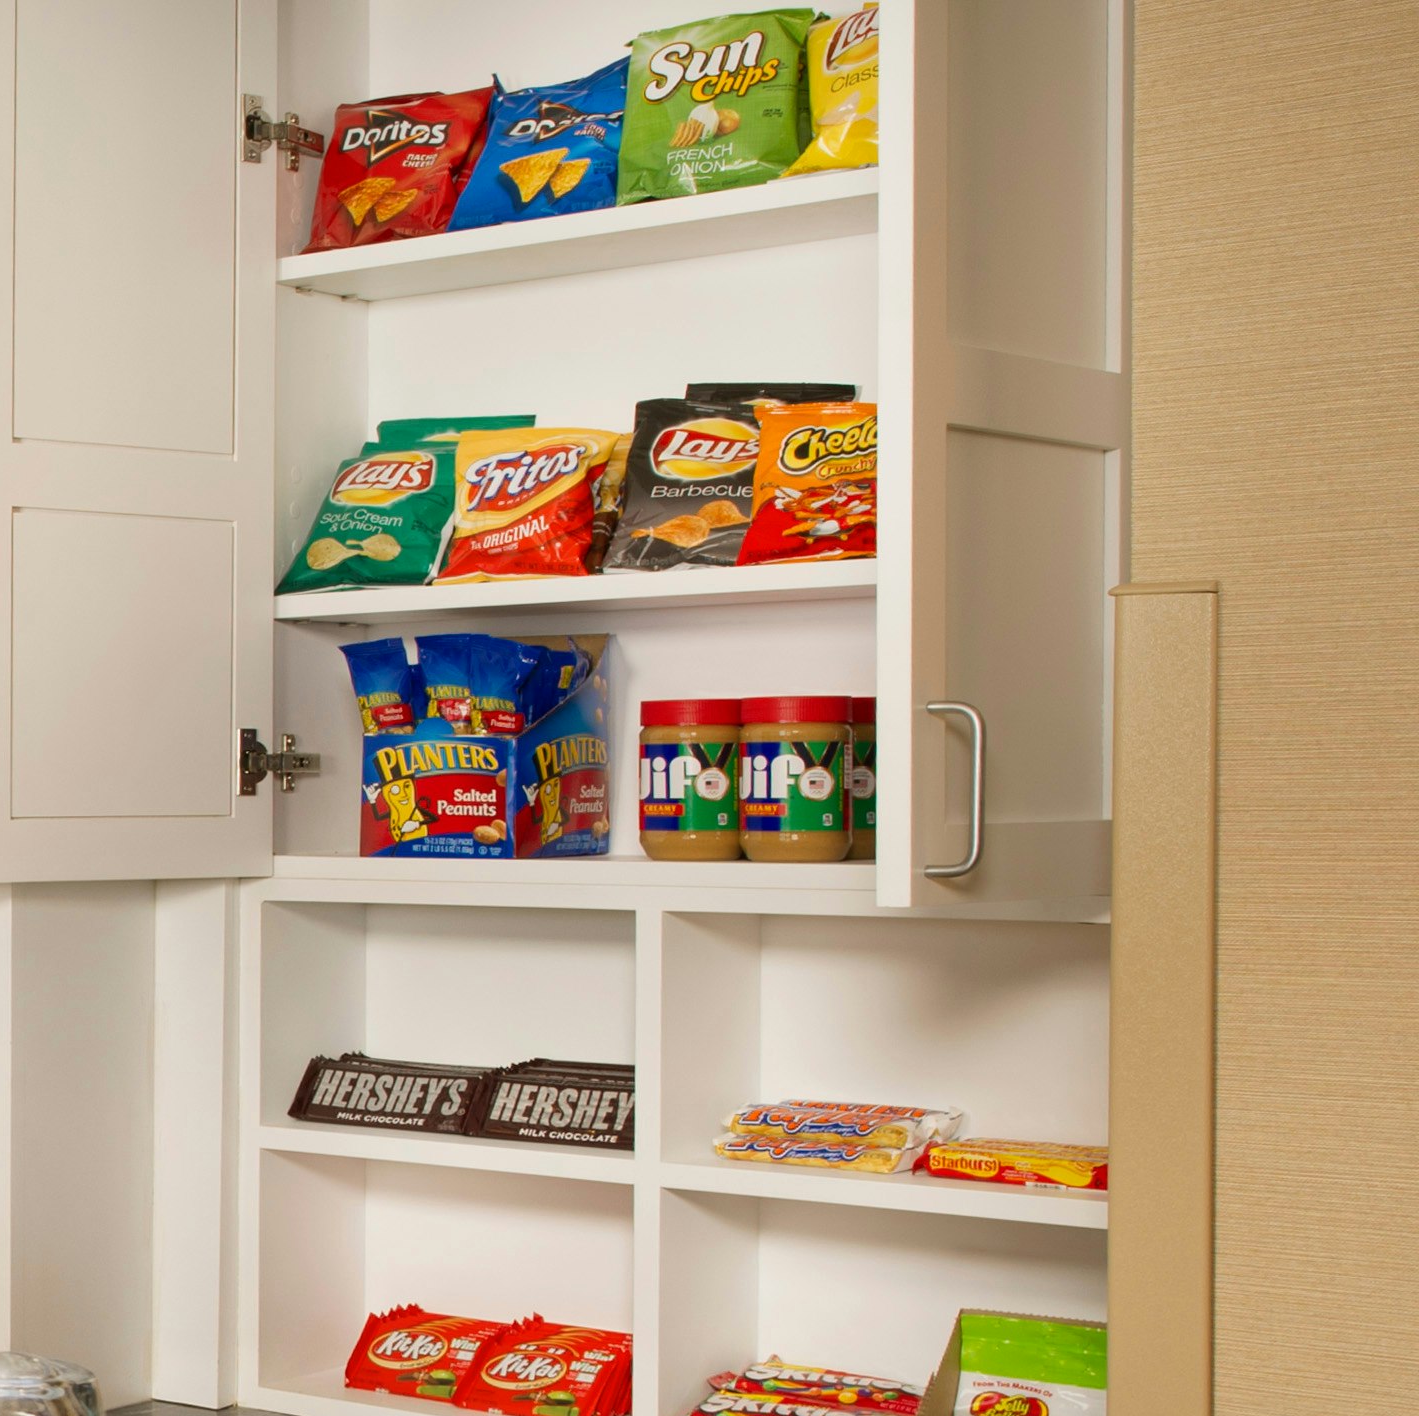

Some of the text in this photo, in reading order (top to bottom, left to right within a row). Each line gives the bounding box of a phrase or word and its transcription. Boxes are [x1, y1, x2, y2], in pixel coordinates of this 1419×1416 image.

[643, 31, 766, 103] Sun
[691, 56, 779, 104] Chips
[830, 63, 880, 92] Class
[342, 118, 448, 155] Doritos
[666, 141, 734, 165] FRENCH
[669, 158, 726, 178] ONION
[335, 456, 433, 491] Lay's
[465, 443, 587, 510] Fritos
[650, 483, 753, 500] Barbecue
[320, 508, 404, 530] Sour Cream
[341, 518, 384, 535] Onion
[482, 518, 550, 549] ORIGINAL
[375, 742, 500, 782] PLANTERS
[535, 736, 607, 779] PLANTERS
[453, 788, 497, 804] Salted
[579, 784, 605, 799] Salted
[437, 800, 497, 817] Peanuts
[312, 1068, 468, 1116] HERSHEY'S
[335, 1111, 426, 1127] MILK CHOCOLATE
[490, 1081, 635, 1132] HERSHEY
[518, 1127, 618, 1144] MILK CHOCOLATE
[930, 1153, 1001, 1178] Starburst
